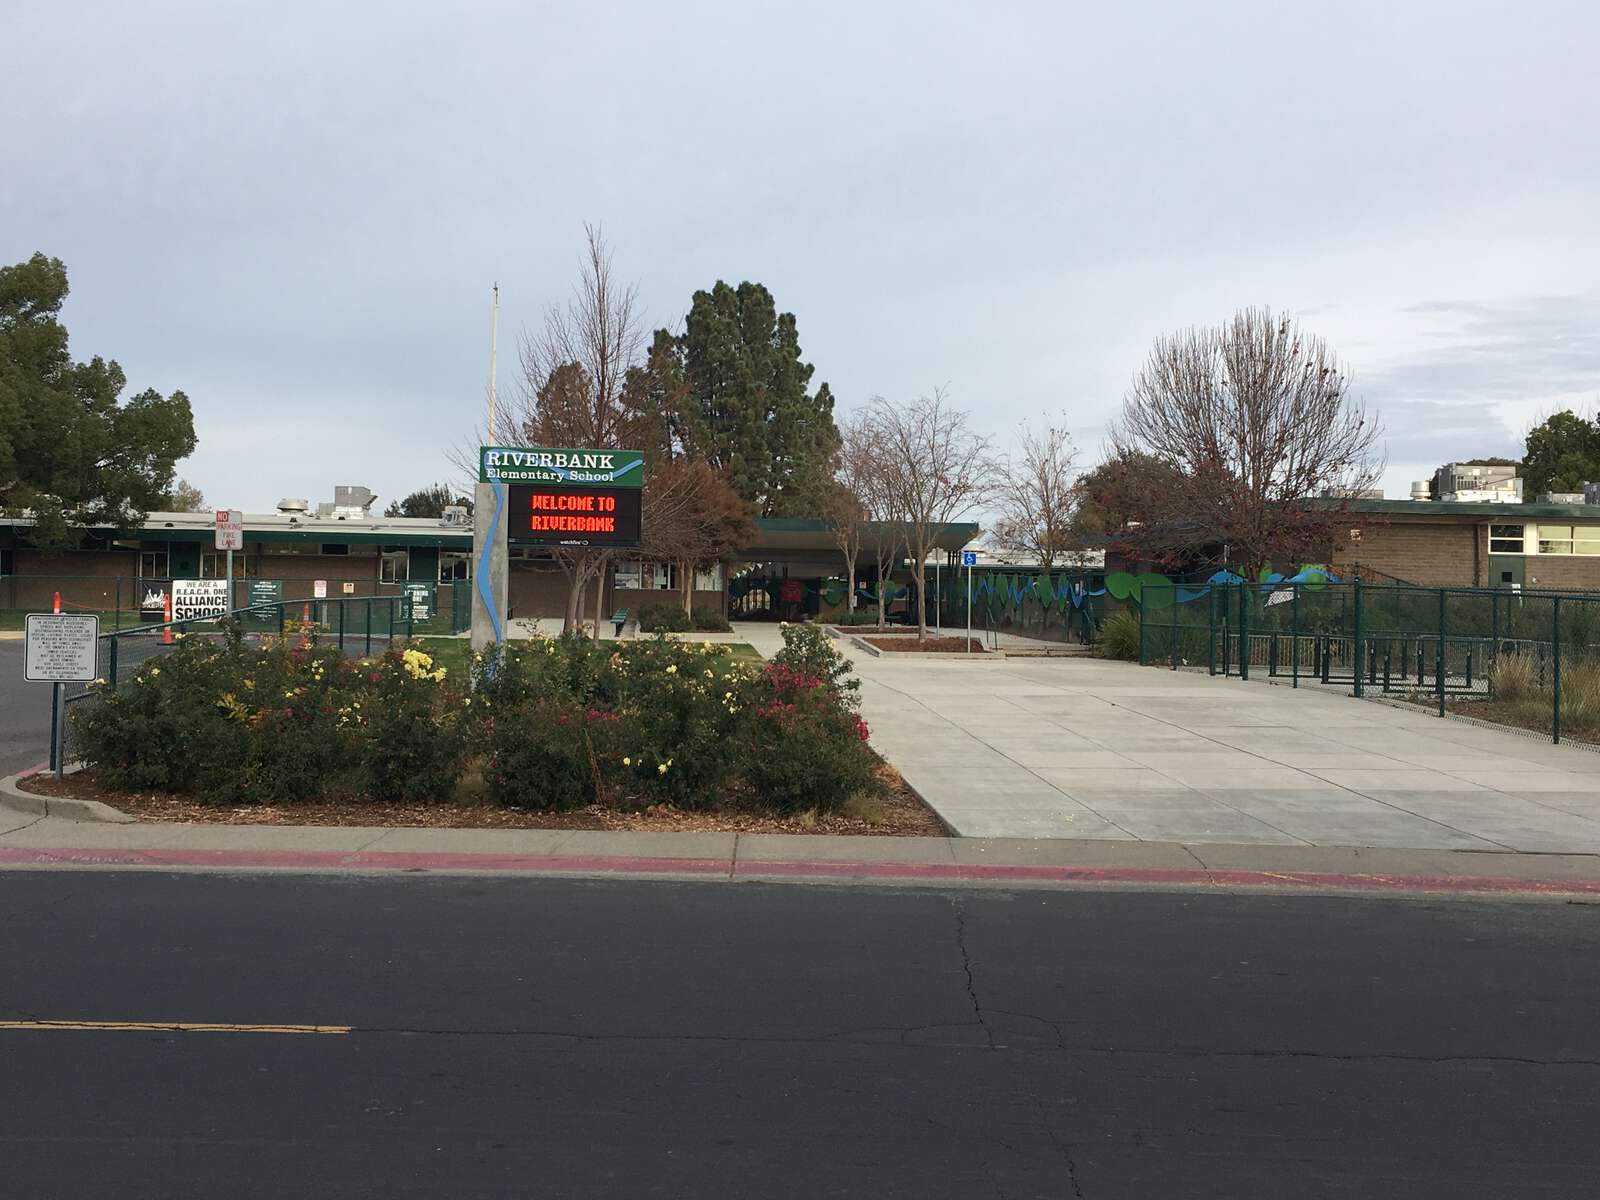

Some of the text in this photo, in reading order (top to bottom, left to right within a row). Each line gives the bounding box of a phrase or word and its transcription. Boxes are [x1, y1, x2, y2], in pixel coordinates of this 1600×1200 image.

[486, 451, 615, 469] RIVERBANK
[486, 468, 614, 482] Elementary School
[532, 495, 615, 511] WELCOME TO
[217, 511, 228, 522] NO
[531, 515, 615, 532] RIVERBANK
[175, 596, 228, 606] ALLIANCE
